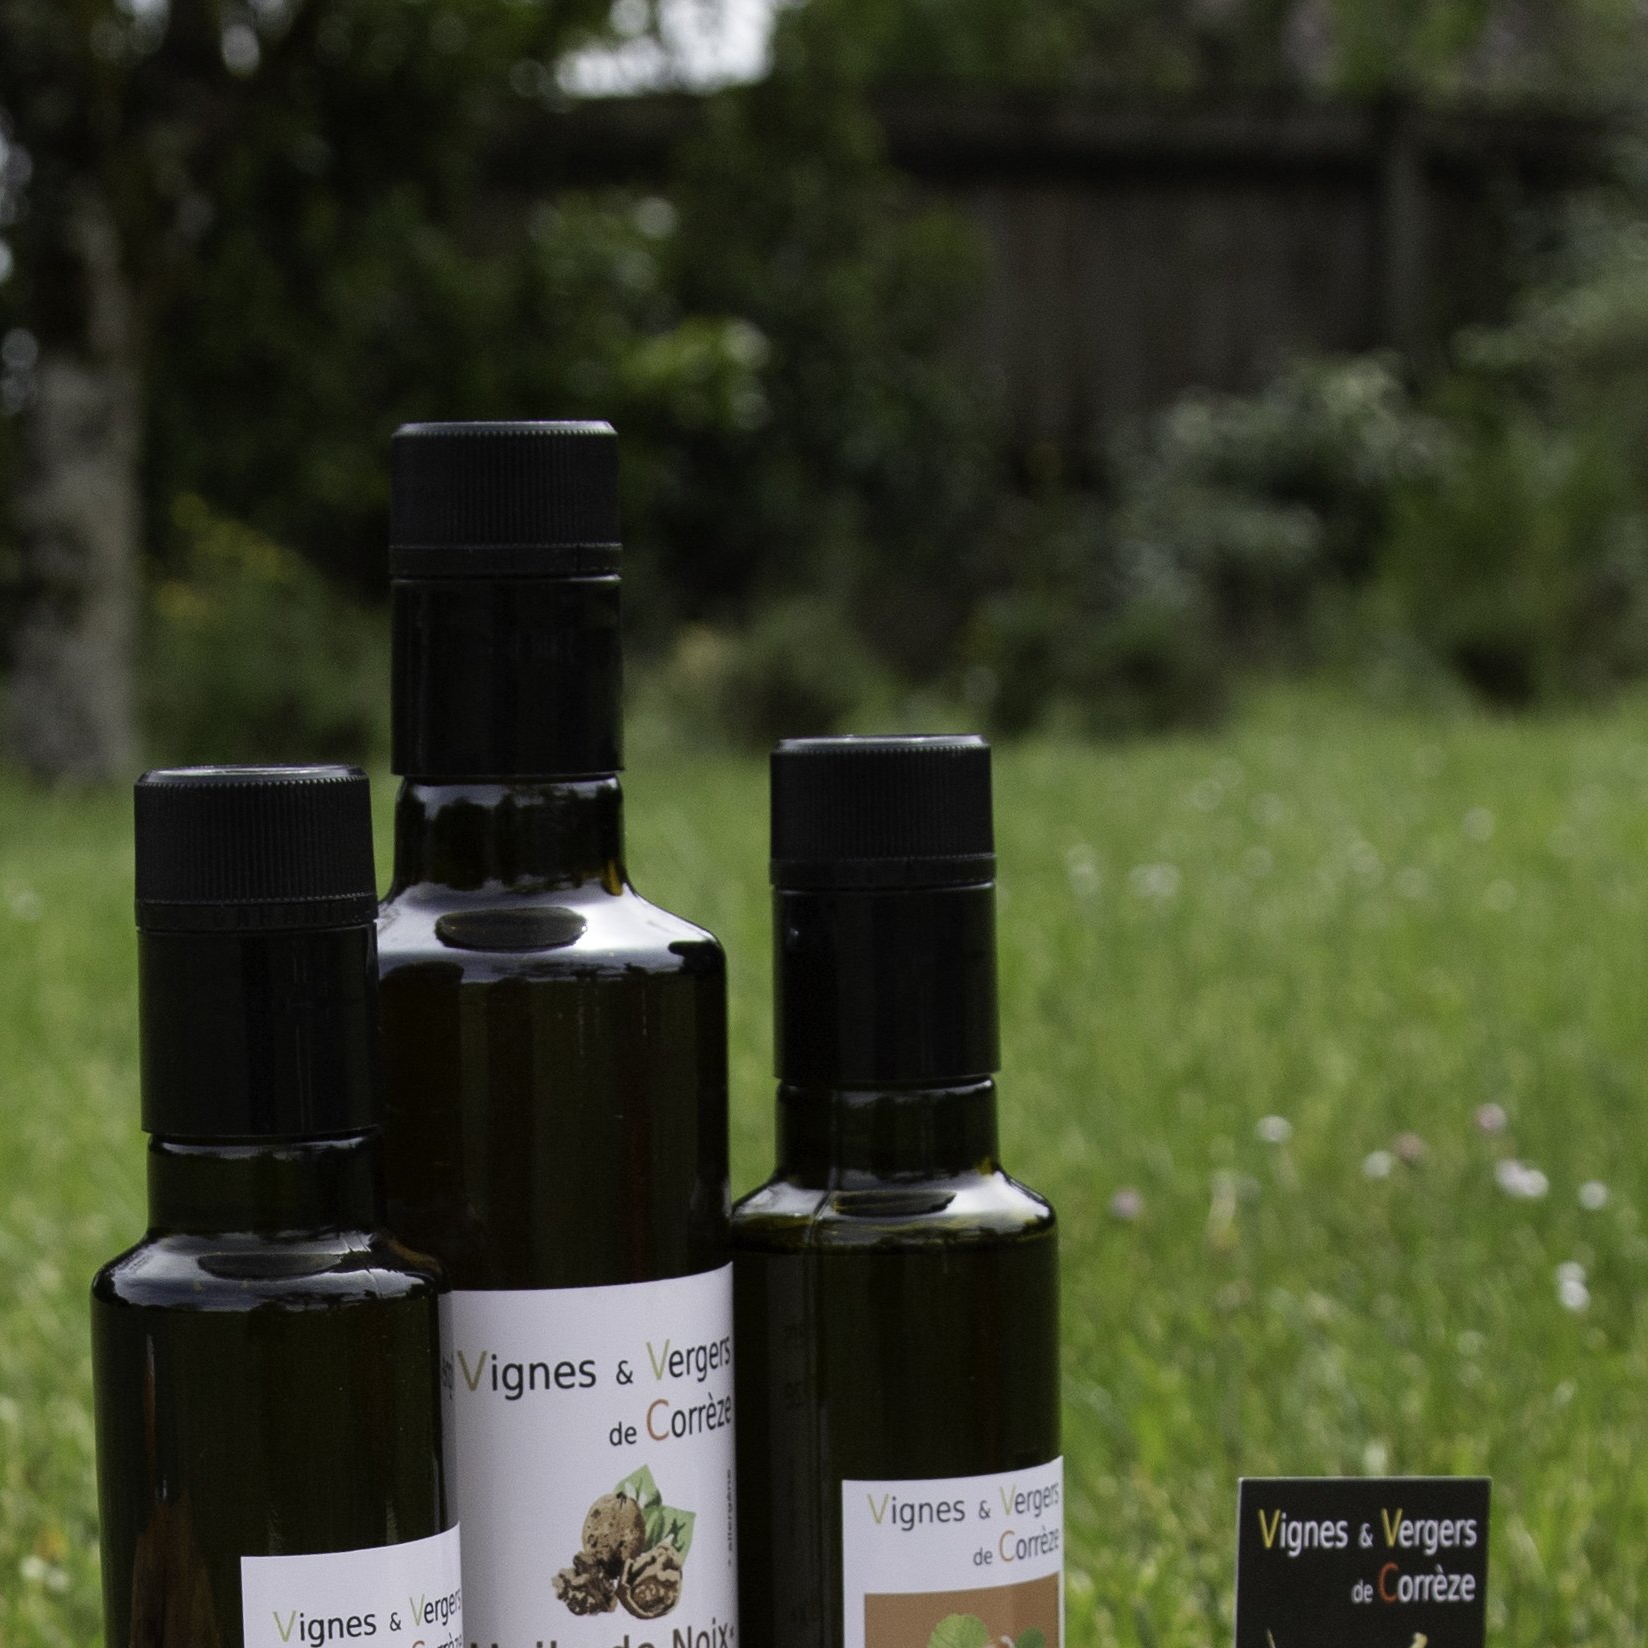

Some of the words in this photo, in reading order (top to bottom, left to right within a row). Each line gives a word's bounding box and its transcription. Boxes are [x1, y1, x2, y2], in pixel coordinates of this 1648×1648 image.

[457, 1350, 597, 1401] Vignes
[615, 1360, 634, 1385] &
[646, 1336, 730, 1382] Vergers
[609, 1421, 637, 1446] de
[646, 1392, 731, 1441] Corrèze
[867, 1493, 966, 1531] Vignes
[978, 1500, 991, 1519] &
[999, 1482, 1059, 1518] Vergers
[973, 1547, 994, 1566] de
[999, 1525, 1059, 1563] Corrèze
[1258, 1508, 1348, 1557] Vignes
[1358, 1522, 1374, 1548] &
[1381, 1507, 1478, 1555] Vergers
[1352, 1579, 1373, 1604] de
[1378, 1562, 1476, 1605] Corrèze
[272, 1610, 377, 1648] Vignes
[389, 1611, 402, 1632] &
